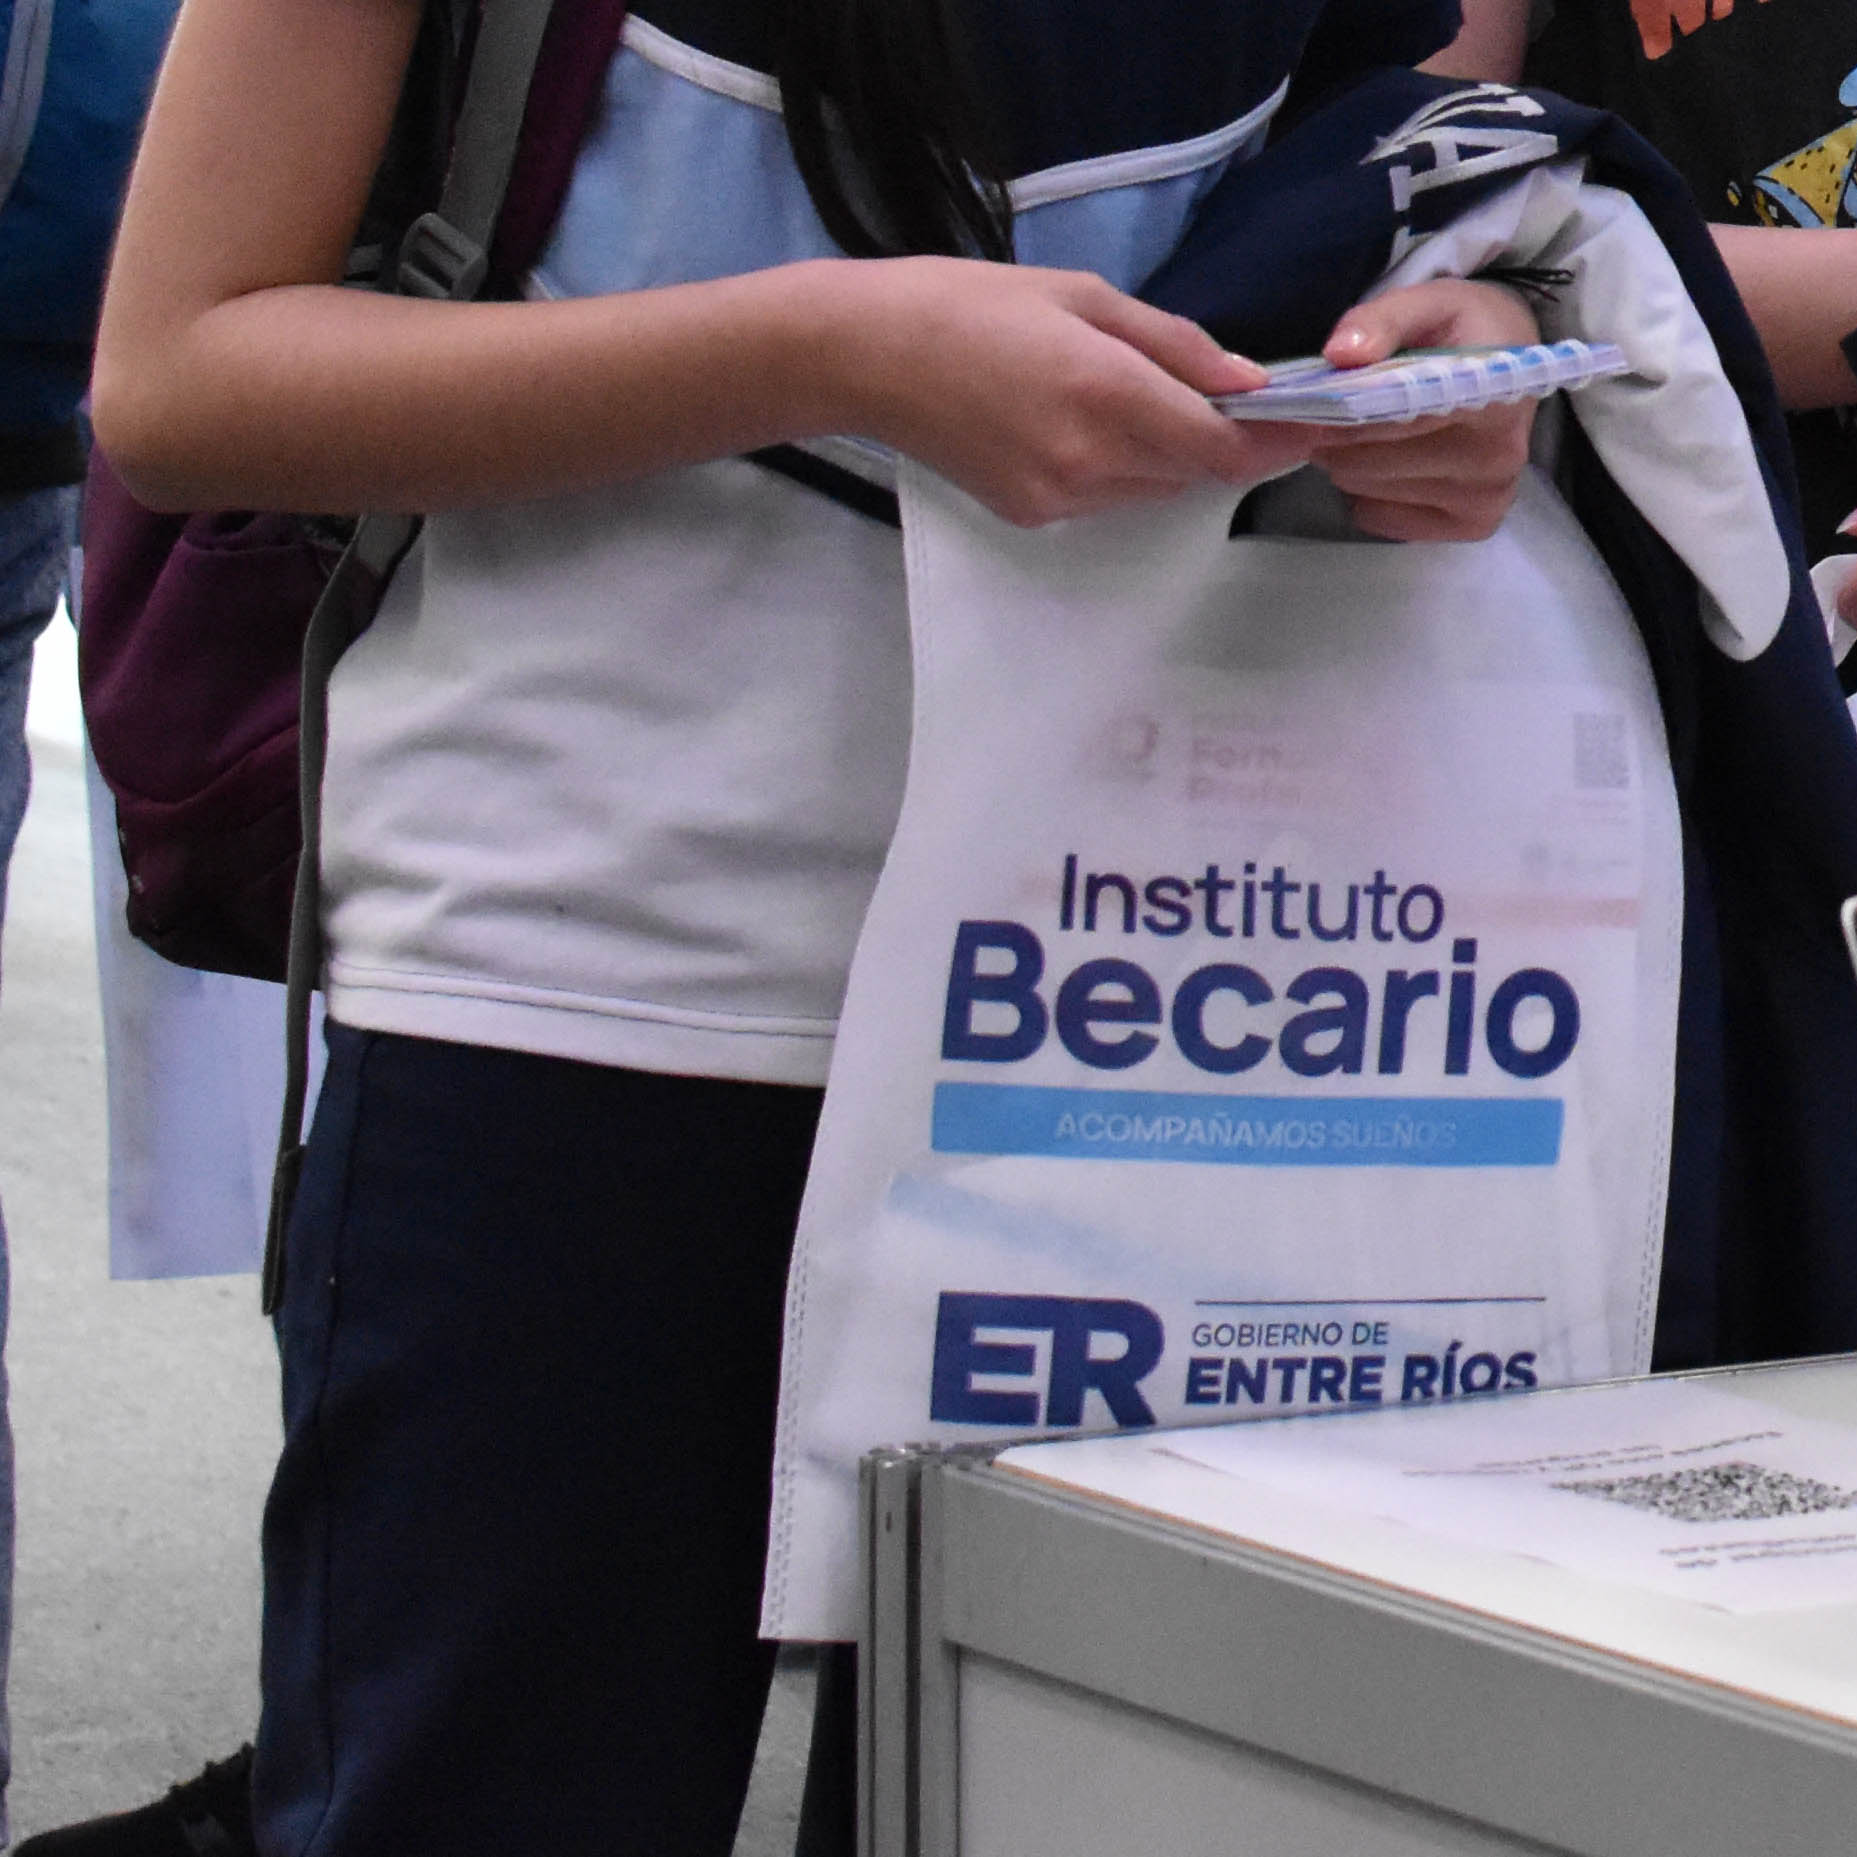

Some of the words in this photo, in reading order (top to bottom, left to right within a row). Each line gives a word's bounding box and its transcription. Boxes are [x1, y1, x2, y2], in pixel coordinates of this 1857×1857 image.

[1060, 854, 1444, 943] Instituto
[940, 919, 1581, 1080] Becario
[1054, 1111, 1327, 1149] ACOMPAÑAMOS
[929, 1290, 1166, 1430] ER
[1185, 1353, 1387, 1405] ENTRE
[1400, 1338, 1538, 1402] RÍOS
[1191, 1322, 1343, 1348] GOBIERNO
[1352, 1321, 1391, 1346] DE
